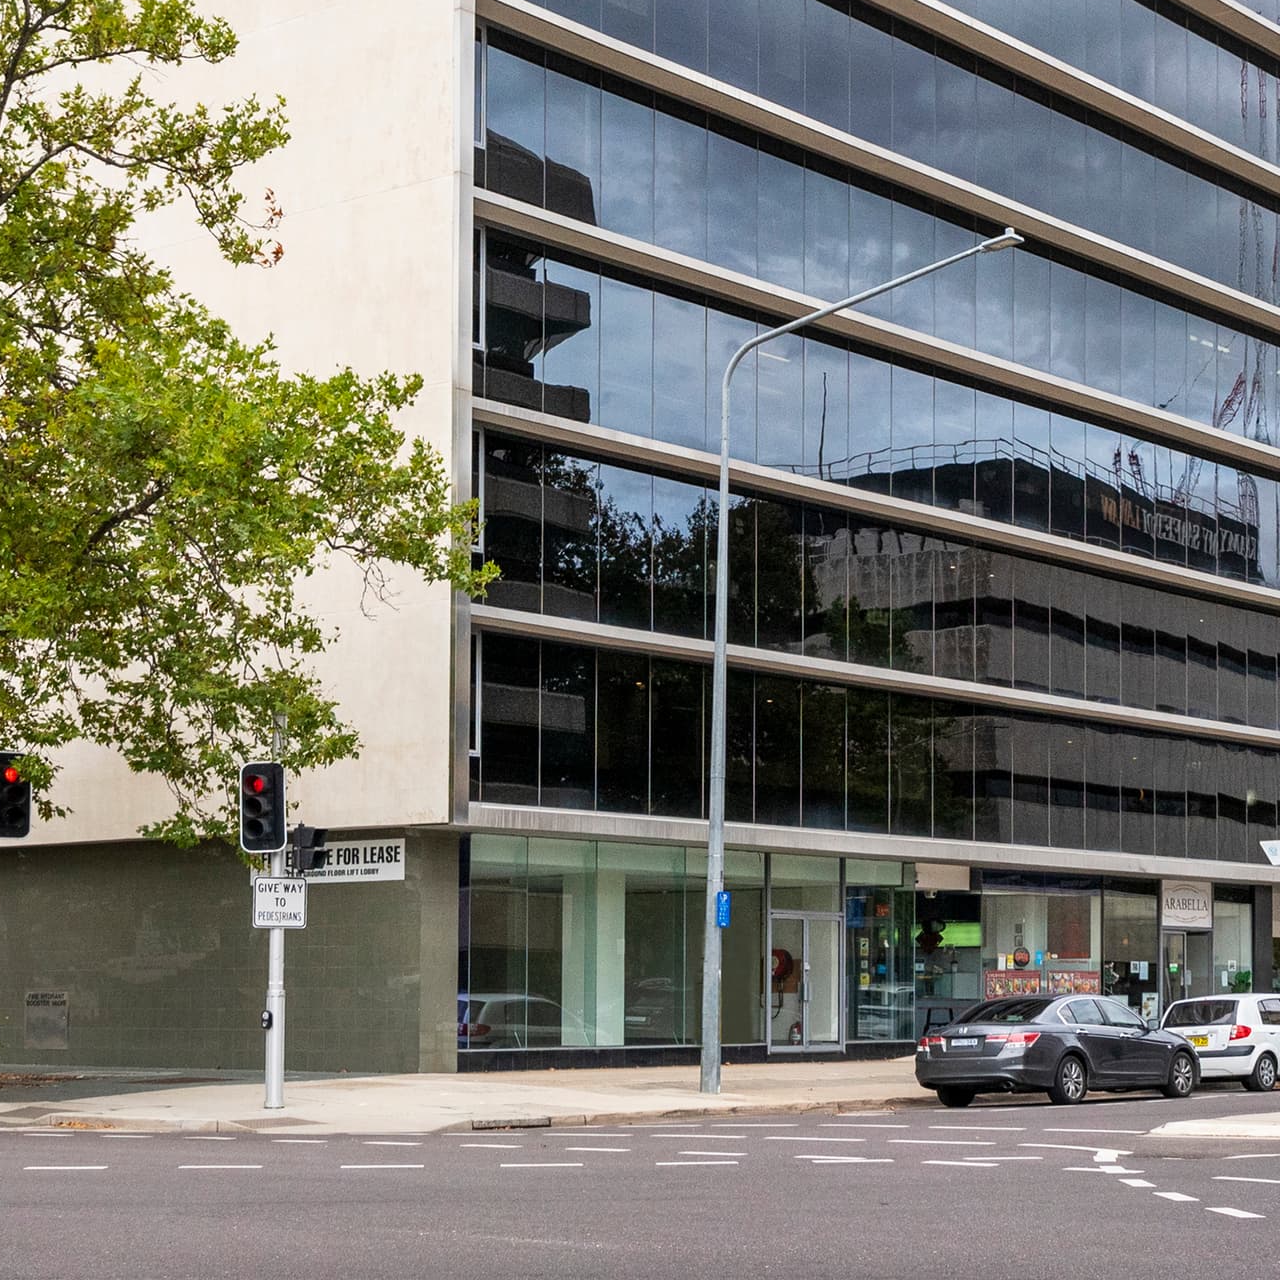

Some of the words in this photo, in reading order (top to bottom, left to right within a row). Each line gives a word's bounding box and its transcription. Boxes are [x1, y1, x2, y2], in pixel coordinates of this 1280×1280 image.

[336, 847, 360, 865] FOR
[363, 845, 400, 864] LEASE
[258, 883, 280, 893] GIVE
[283, 883, 303, 893] WAY
[275, 897, 286, 907] TO
[1164, 897, 1208, 911] ARABELLA
[258, 911, 302, 922] PEDESTRIANS
